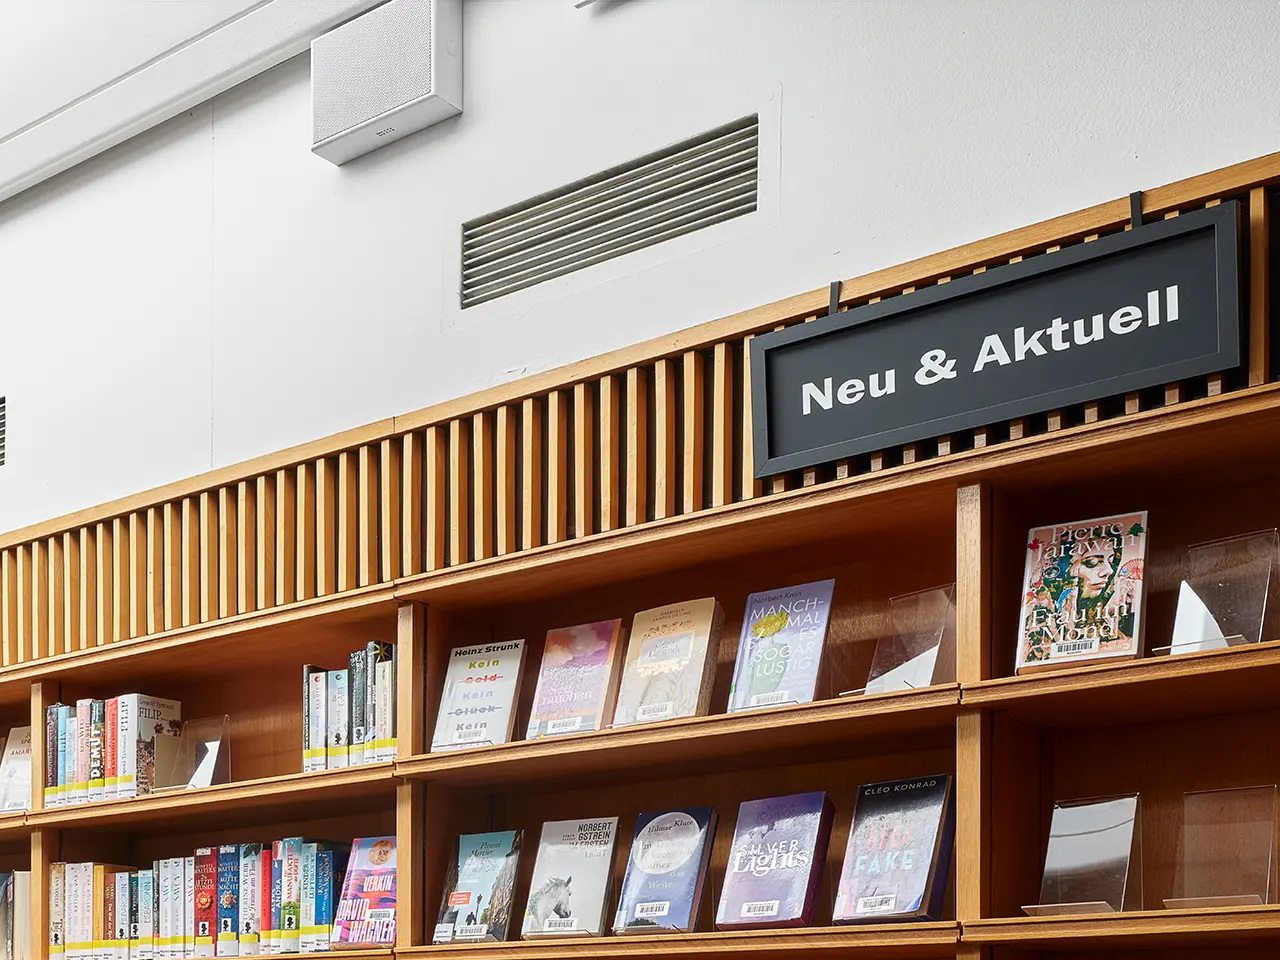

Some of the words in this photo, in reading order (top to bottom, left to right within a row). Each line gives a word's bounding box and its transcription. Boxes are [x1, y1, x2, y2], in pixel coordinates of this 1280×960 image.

[801, 368, 897, 416] Neu
[914, 348, 958, 387] &
[972, 284, 1181, 374] Aktuell
[1051, 521, 1125, 545] Pierre
[1035, 533, 1137, 563] Jarawan
[752, 593, 783, 605] Norbert
[749, 597, 824, 622] MANCH-
[1031, 607, 1087, 628] Frau
[1096, 600, 1128, 620] im
[787, 611, 821, 629] MAL
[799, 626, 818, 642] ES
[1041, 617, 1116, 641] Mond
[454, 647, 483, 658] Heinz
[484, 641, 520, 654] Strunk
[753, 642, 815, 663] SOGAR
[468, 658, 500, 670] Kein
[755, 656, 812, 678] LUSTIG
[462, 689, 494, 700] Kein
[120, 701, 129, 732] FILIP
[138, 707, 162, 721] FILIP
[455, 721, 487, 732] Kein
[864, 786, 890, 796] CLEO
[893, 780, 937, 792] KONRAD
[577, 821, 613, 833] NORBERT
[647, 825, 672, 834] Hilmar
[673, 819, 694, 828] Klute
[577, 831, 611, 841] GSTREIN
[470, 849, 495, 858] Mercier
[480, 840, 502, 850] Pascal
[739, 838, 799, 855] SILVER
[732, 849, 811, 877] Lights
[854, 850, 917, 874] FAKE
[363, 875, 394, 892] VERKIN
[648, 880, 673, 889] Weite
[336, 899, 370, 920] DAVID
[348, 919, 396, 943] WAGNER
